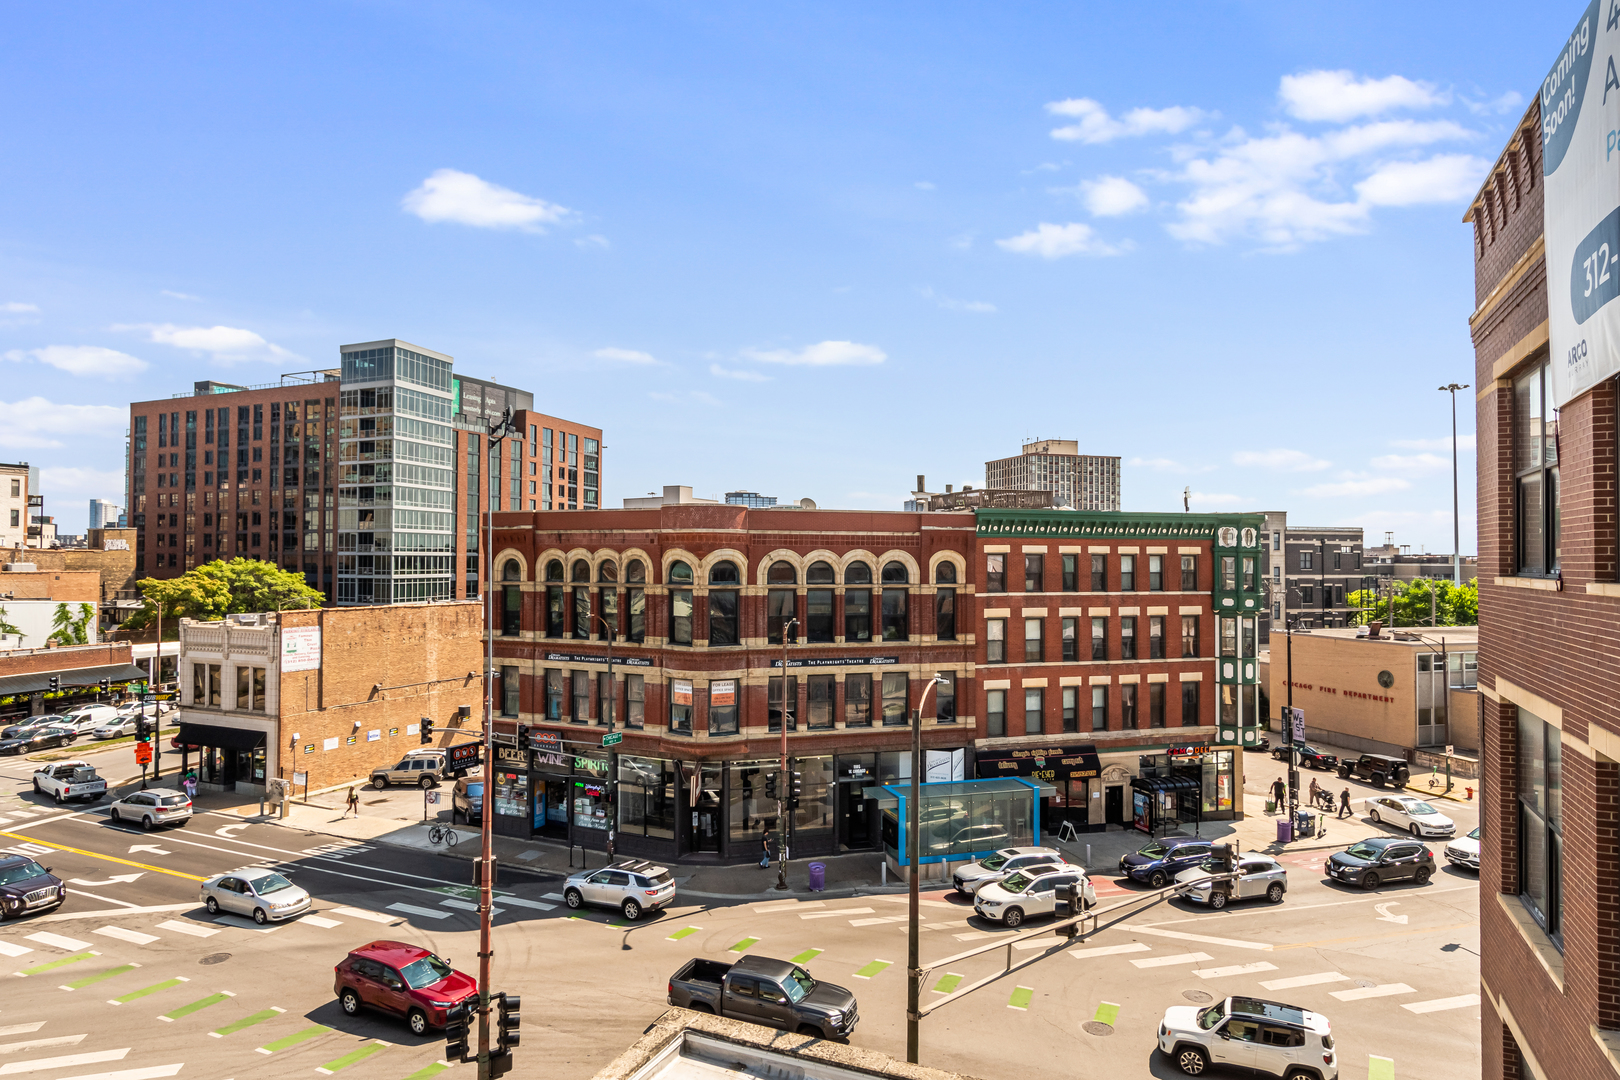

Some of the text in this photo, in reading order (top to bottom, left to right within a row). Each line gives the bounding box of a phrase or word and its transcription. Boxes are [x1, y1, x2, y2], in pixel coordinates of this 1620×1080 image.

[1543, 16, 1590, 107] Coming
[1543, 74, 1576, 145] Soon!
[1567, 339, 1588, 368] ARCO
[143, 693, 173, 702] SUBWAY
[1282, 680, 1395, 704] CICAGO FIRE DEPARTMENT
[498, 747, 525, 761] BEER
[537, 752, 566, 766] WINE
[1194, 746, 1211, 754] DELI
